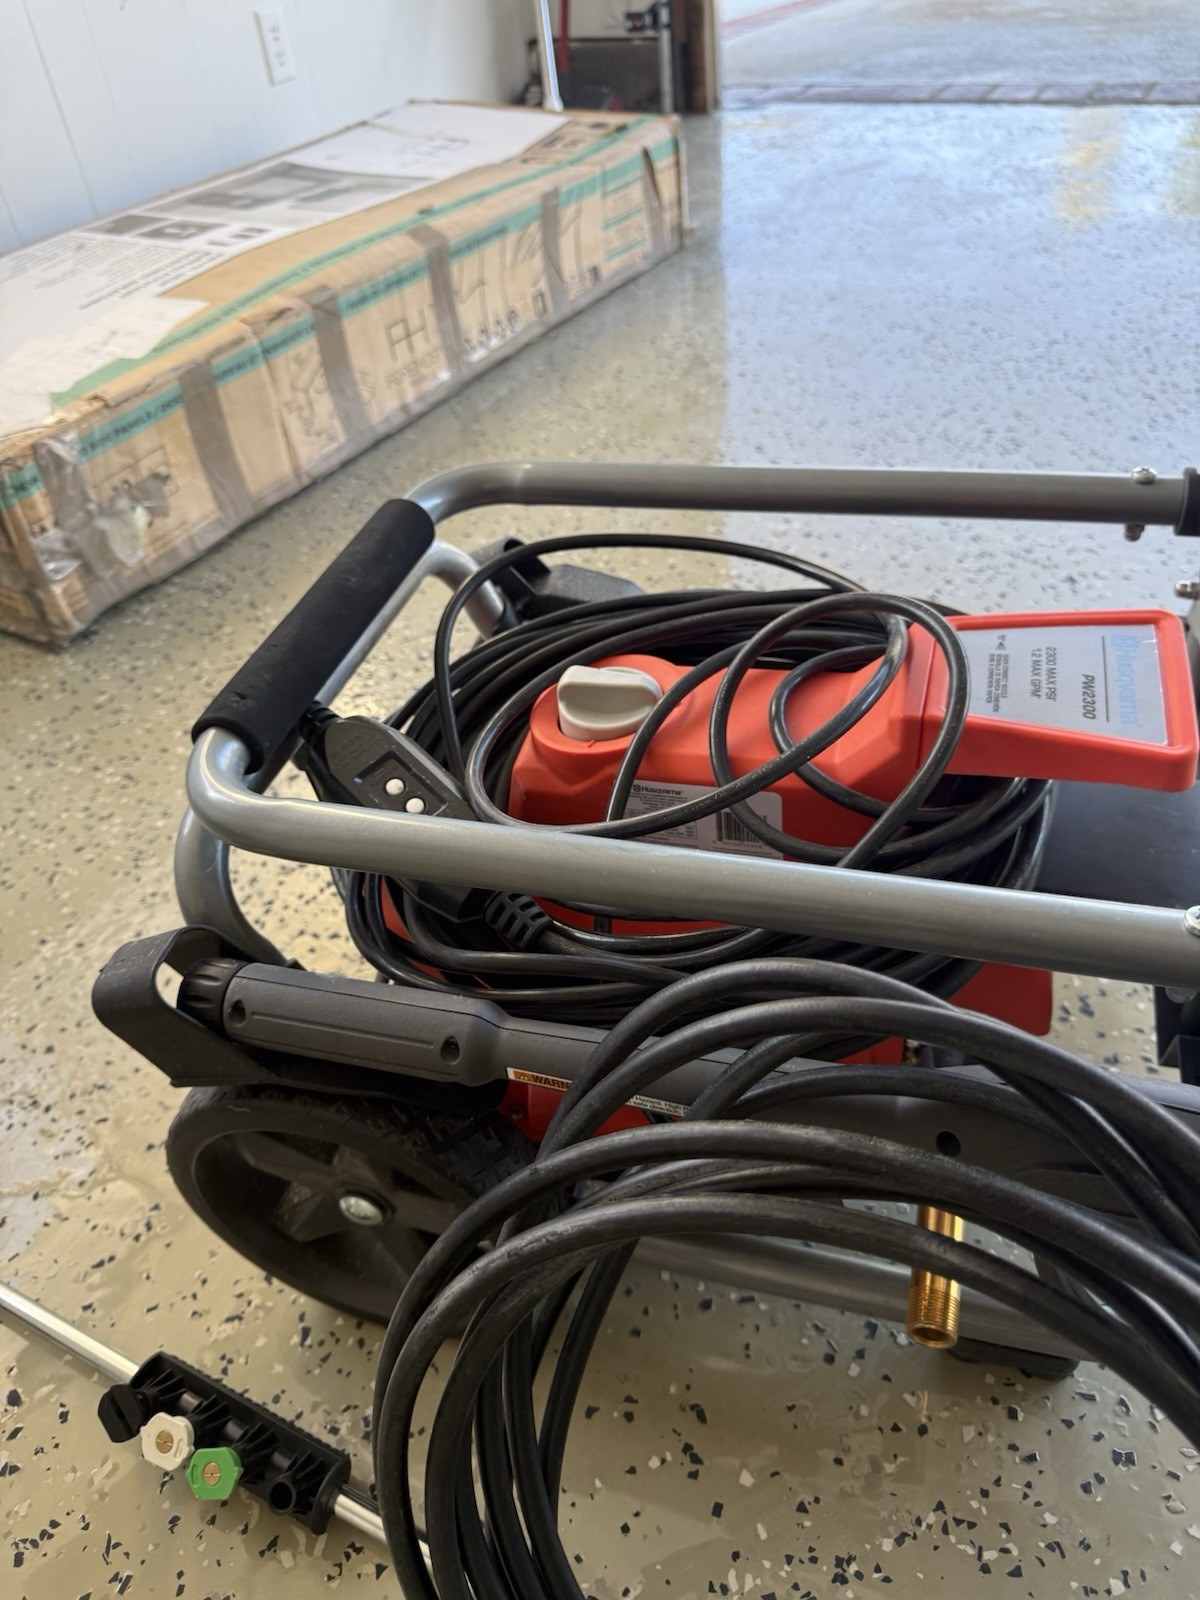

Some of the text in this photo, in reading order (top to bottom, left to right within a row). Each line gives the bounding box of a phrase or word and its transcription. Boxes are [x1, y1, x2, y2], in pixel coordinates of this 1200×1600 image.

[1045, 646, 1057, 666] 2300
[1030, 659, 1042, 677] MAX
[1045, 667, 1057, 686] MAX
[1081, 673, 1097, 720] PW2300
[641, 785, 682, 796] Husqvarna
[664, 1101, 682, 1111] High
